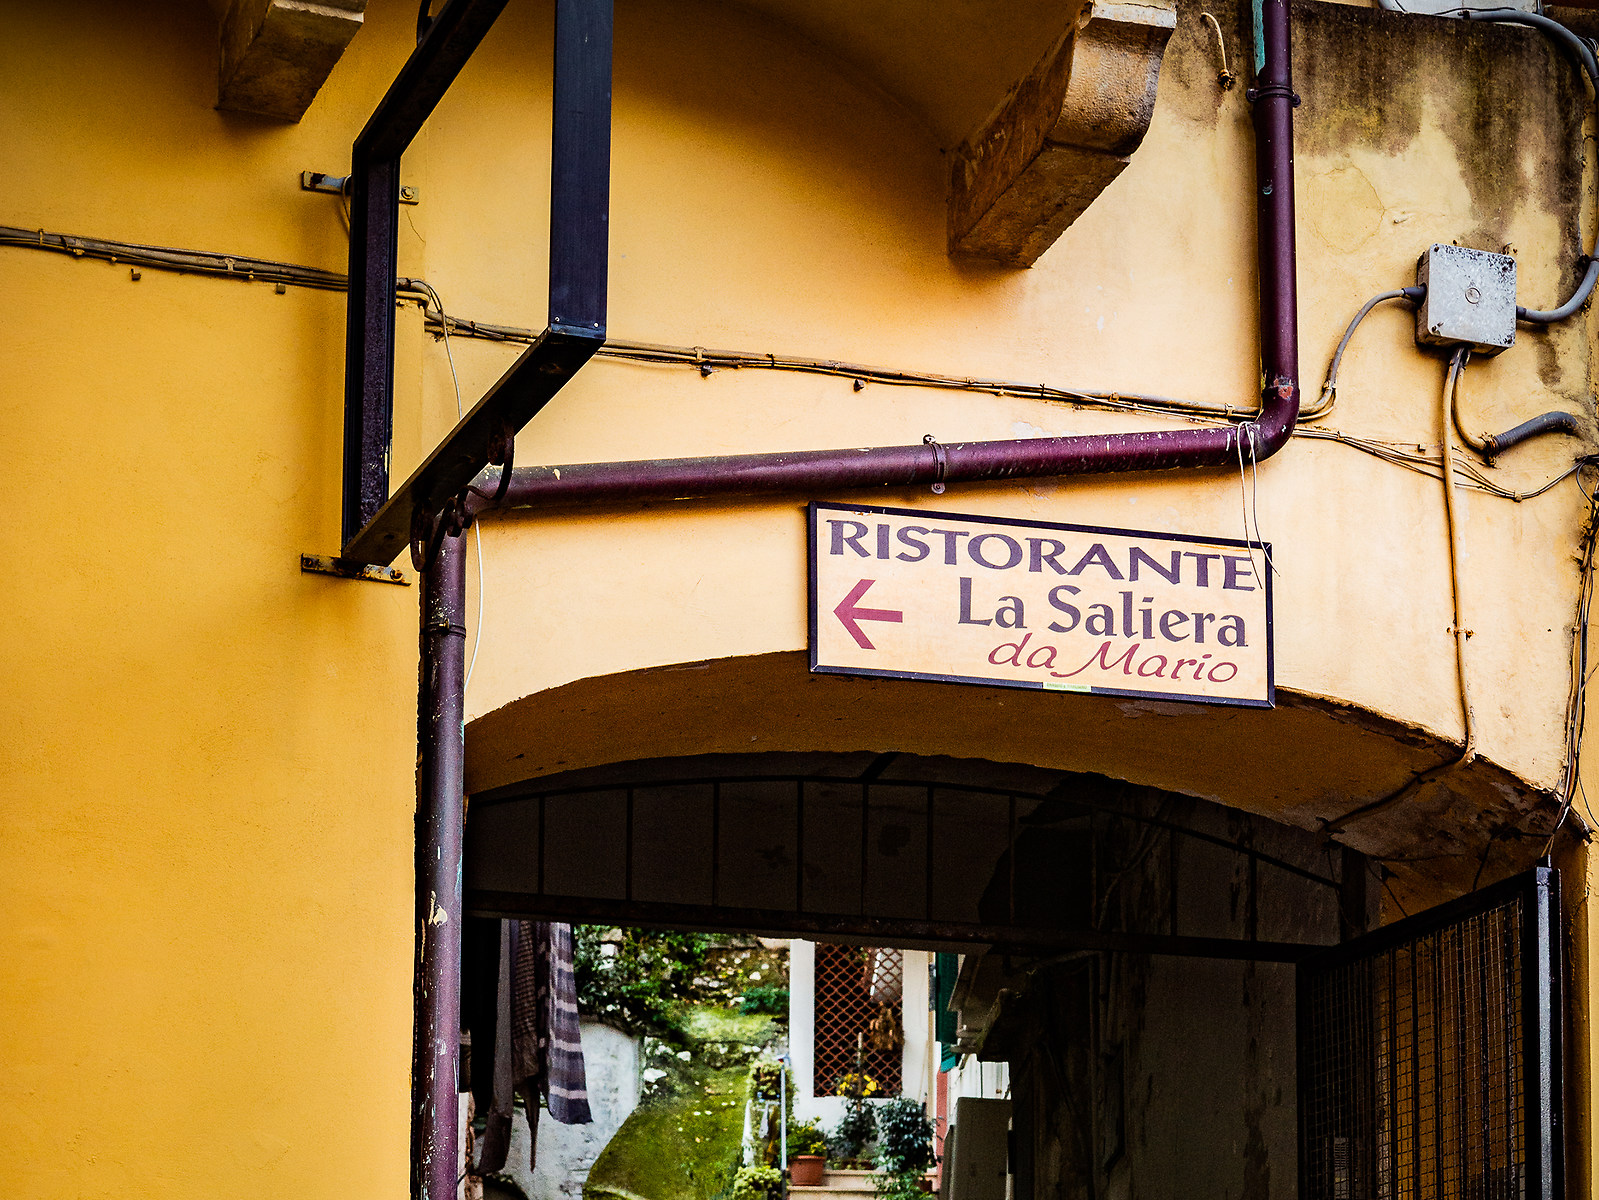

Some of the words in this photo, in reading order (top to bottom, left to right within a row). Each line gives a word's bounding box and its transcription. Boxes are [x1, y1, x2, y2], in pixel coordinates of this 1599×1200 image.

[826, 519, 1256, 592] RISTORANTE
[958, 577, 1027, 629] La
[1047, 584, 1249, 647] Saliera
[987, 632, 1057, 669] da
[1050, 640, 1238, 684] Mario
